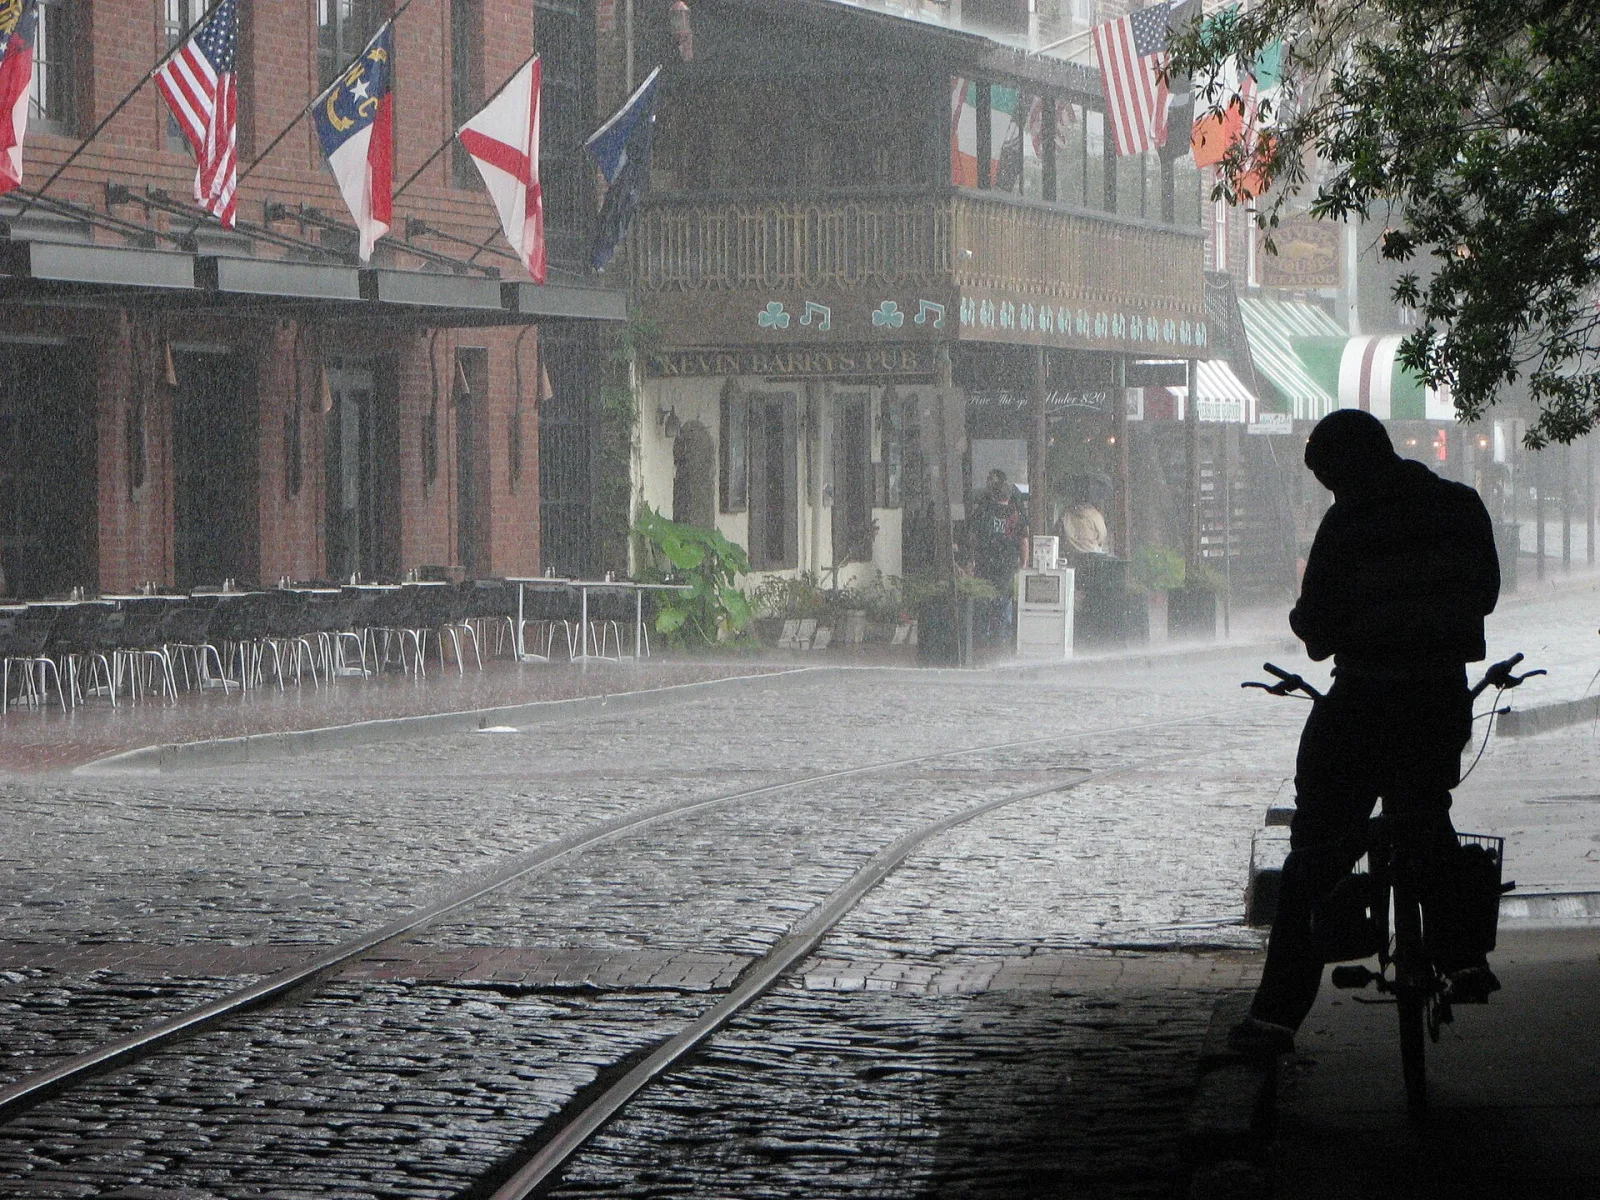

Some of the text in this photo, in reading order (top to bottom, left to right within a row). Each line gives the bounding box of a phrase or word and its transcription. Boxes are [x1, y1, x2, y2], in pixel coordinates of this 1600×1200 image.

[663, 354, 741, 375] KEVIN
[865, 350, 919, 372] PUB
[999, 390, 1028, 410] Thigs
[1044, 390, 1077, 405] Under
